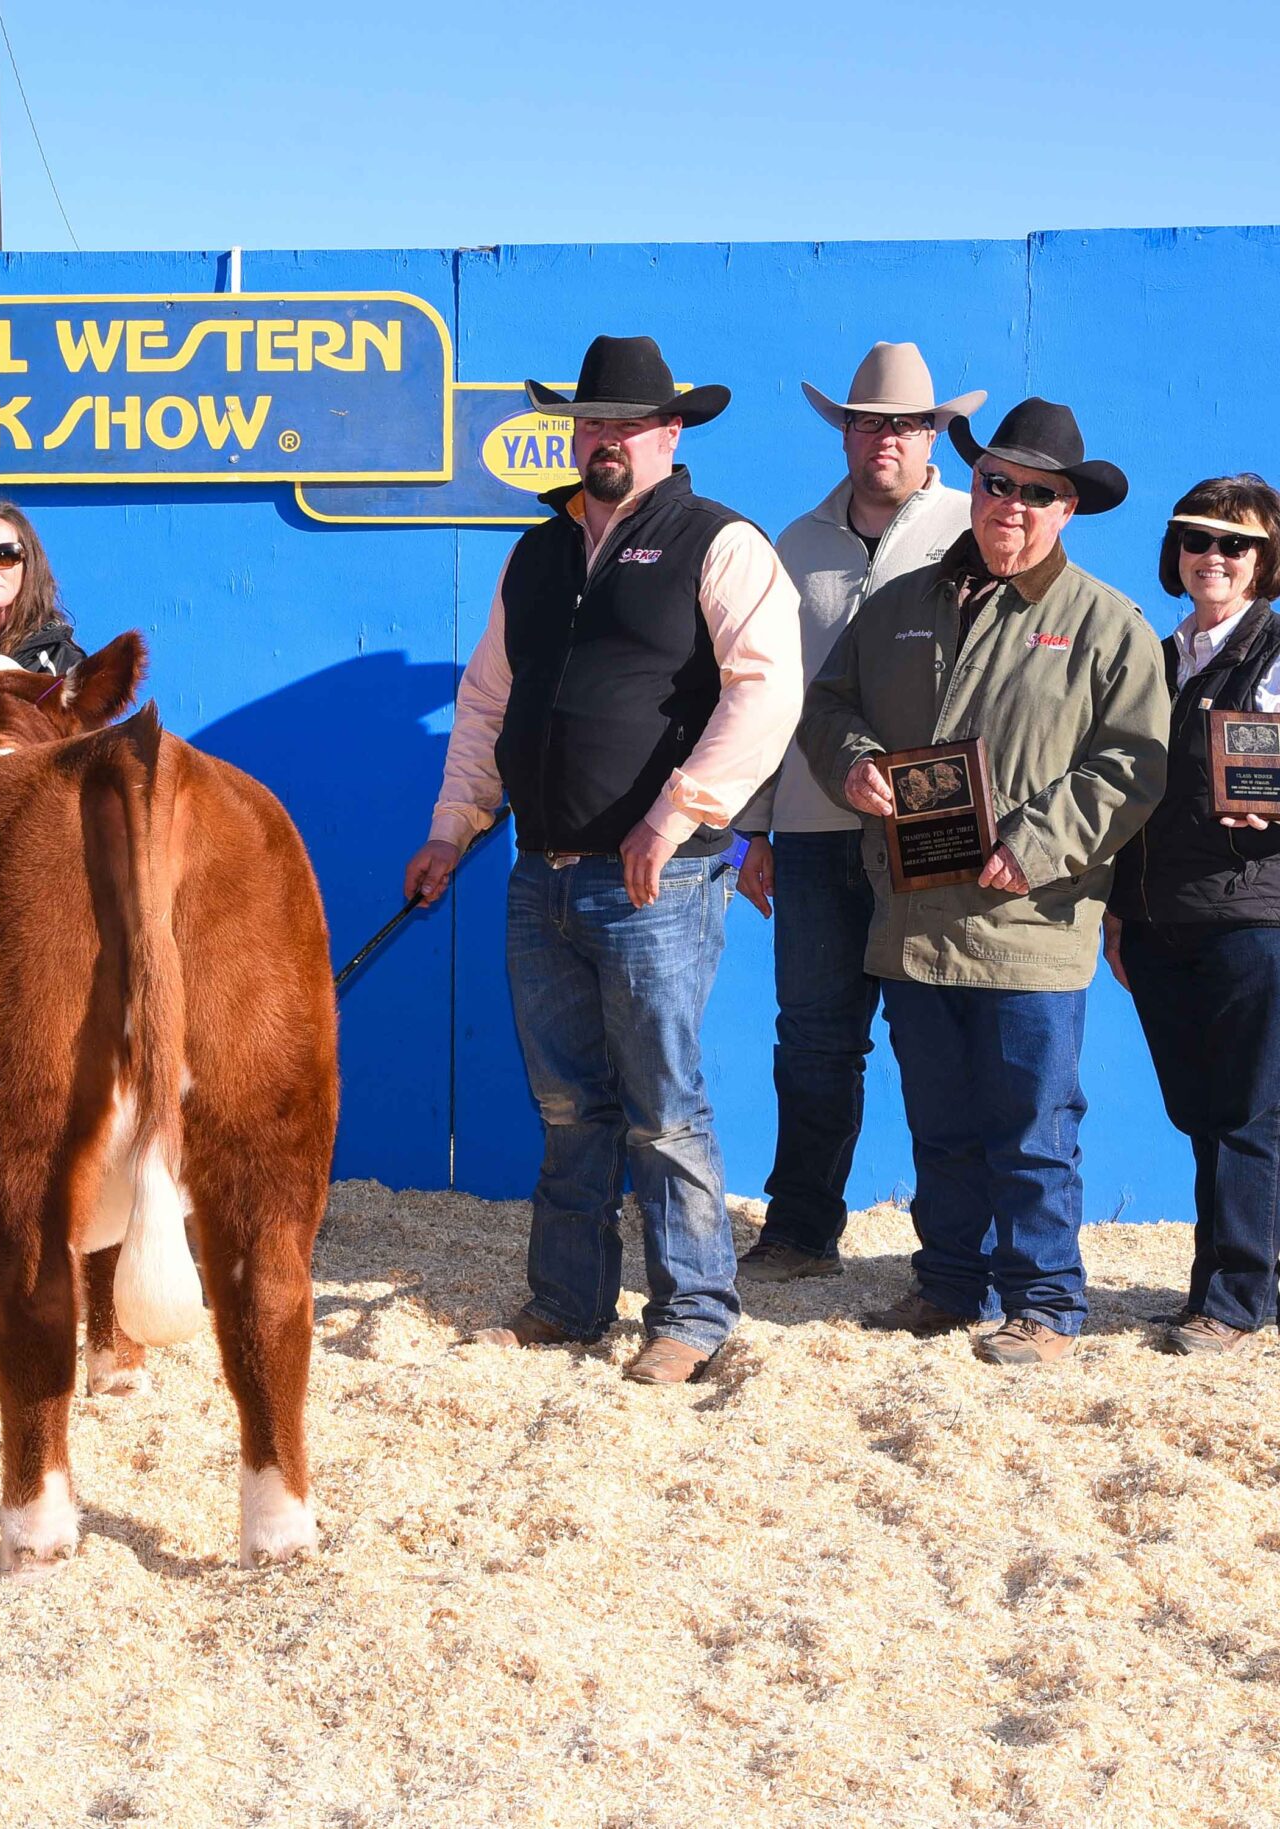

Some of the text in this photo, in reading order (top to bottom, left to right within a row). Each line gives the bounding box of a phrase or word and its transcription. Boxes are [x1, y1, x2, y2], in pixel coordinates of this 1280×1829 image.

[55, 319, 402, 373] WESTERN
[43, 395, 272, 450] SHOW
[538, 420, 571, 431] IN THE
